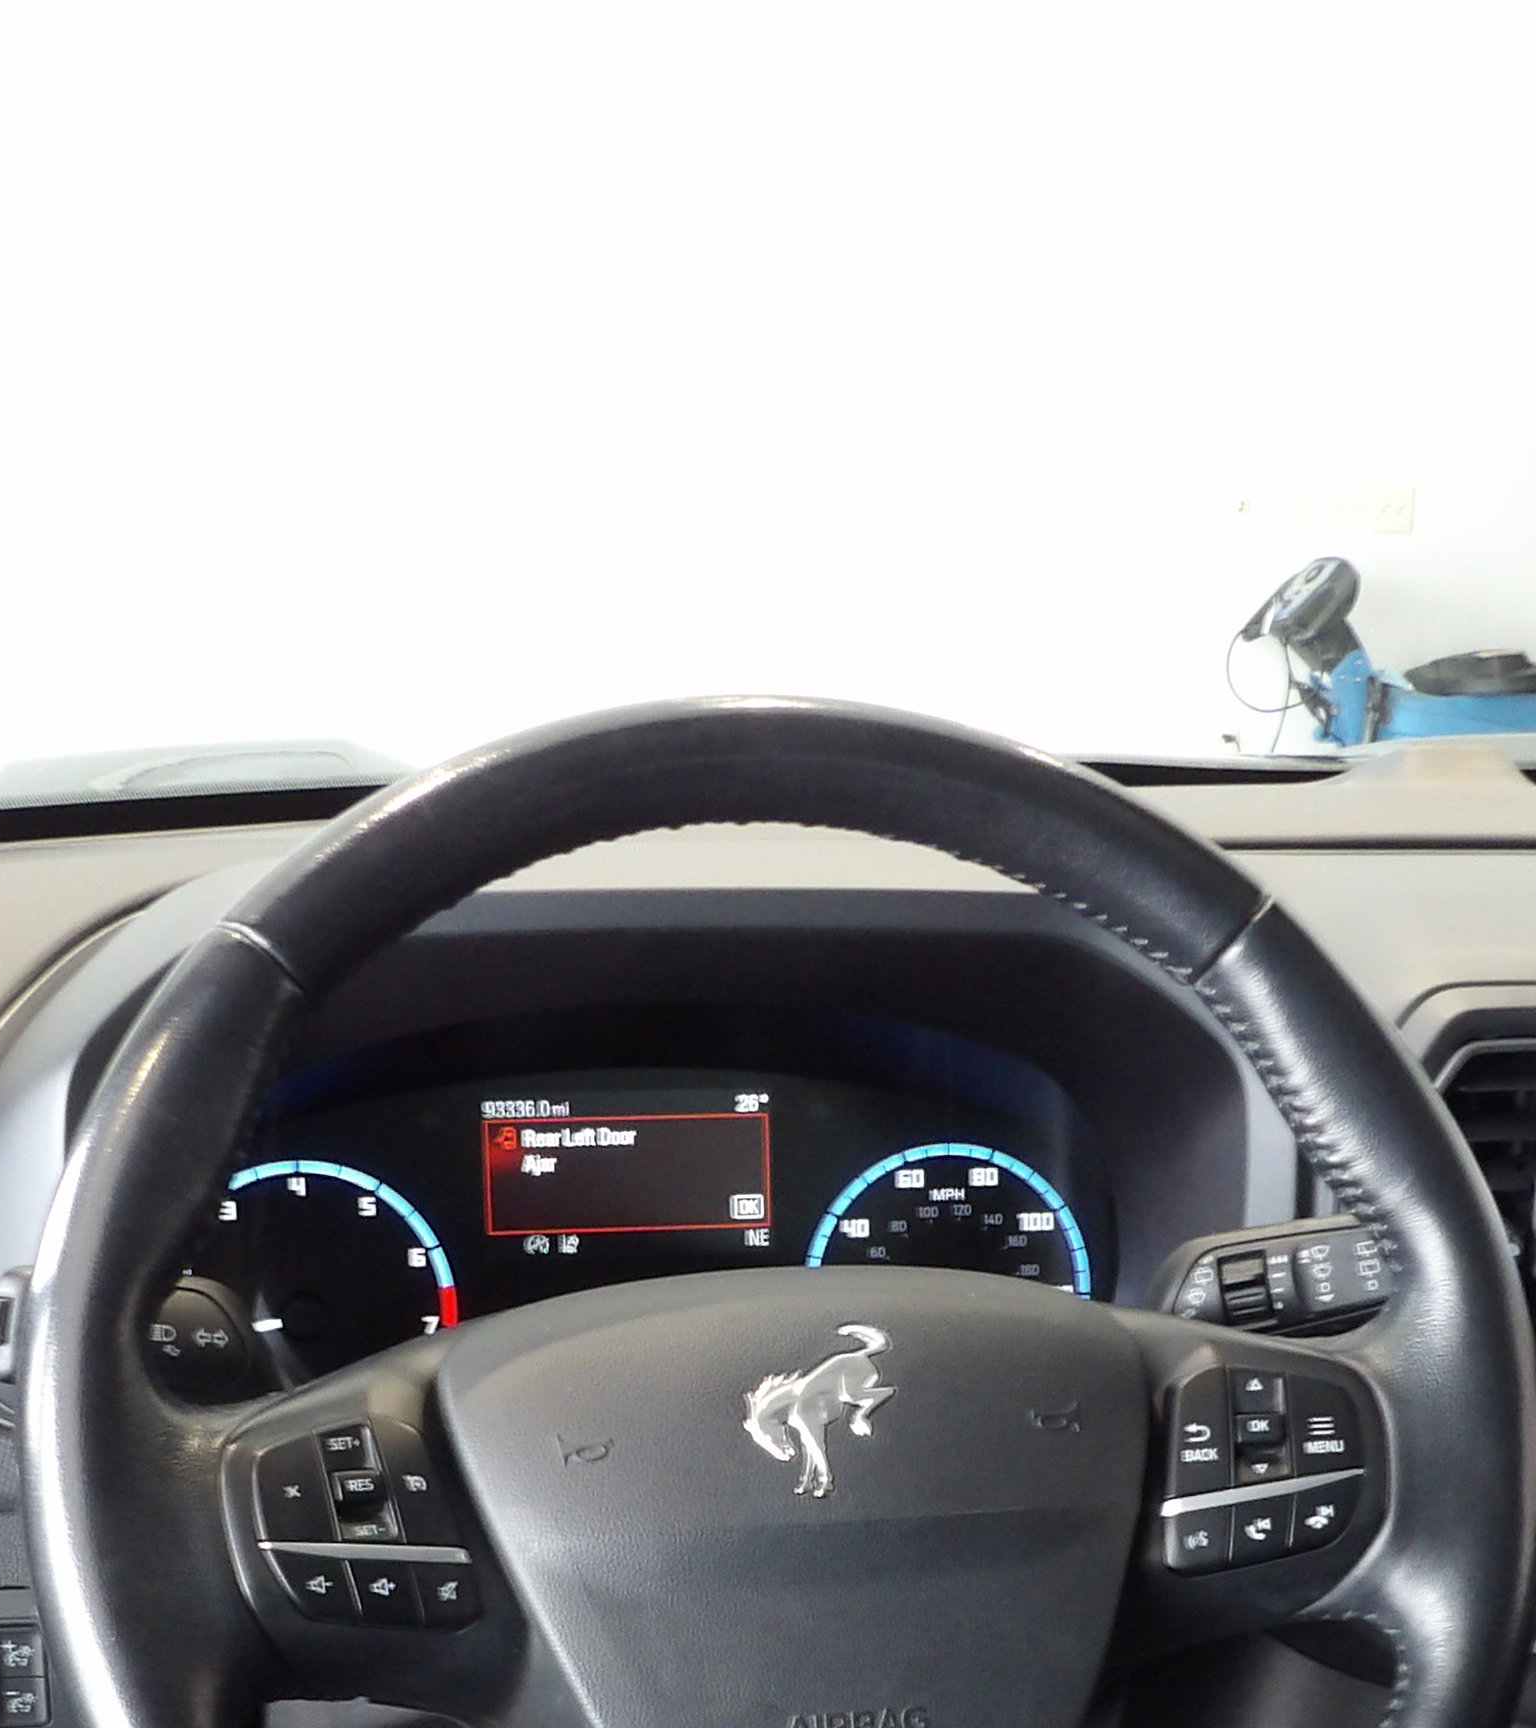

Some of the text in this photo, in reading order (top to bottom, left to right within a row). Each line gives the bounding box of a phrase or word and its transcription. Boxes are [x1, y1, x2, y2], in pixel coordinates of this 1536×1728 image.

[481, 1100, 570, 1118] 93336.0 mi
[520, 1127, 637, 1147] Rear Left Door
[520, 1154, 557, 1176] Ajar
[287, 1177, 307, 1196] 4
[894, 1169, 925, 1188] 60
[968, 1167, 999, 1187] 80
[928, 1188, 965, 1201] MPH
[218, 1201, 238, 1221] 3
[358, 1197, 378, 1217] 5
[839, 1219, 870, 1238] 40
[1016, 1212, 1055, 1231] 100
[744, 1229, 770, 1247] NE
[408, 1247, 427, 1267] 6
[421, 1316, 440, 1335] 7
[1246, 1420, 1270, 1433] OK
[1180, 1447, 1220, 1463] BACK
[1302, 1439, 1345, 1455] MENU
[344, 1478, 375, 1493] RES
